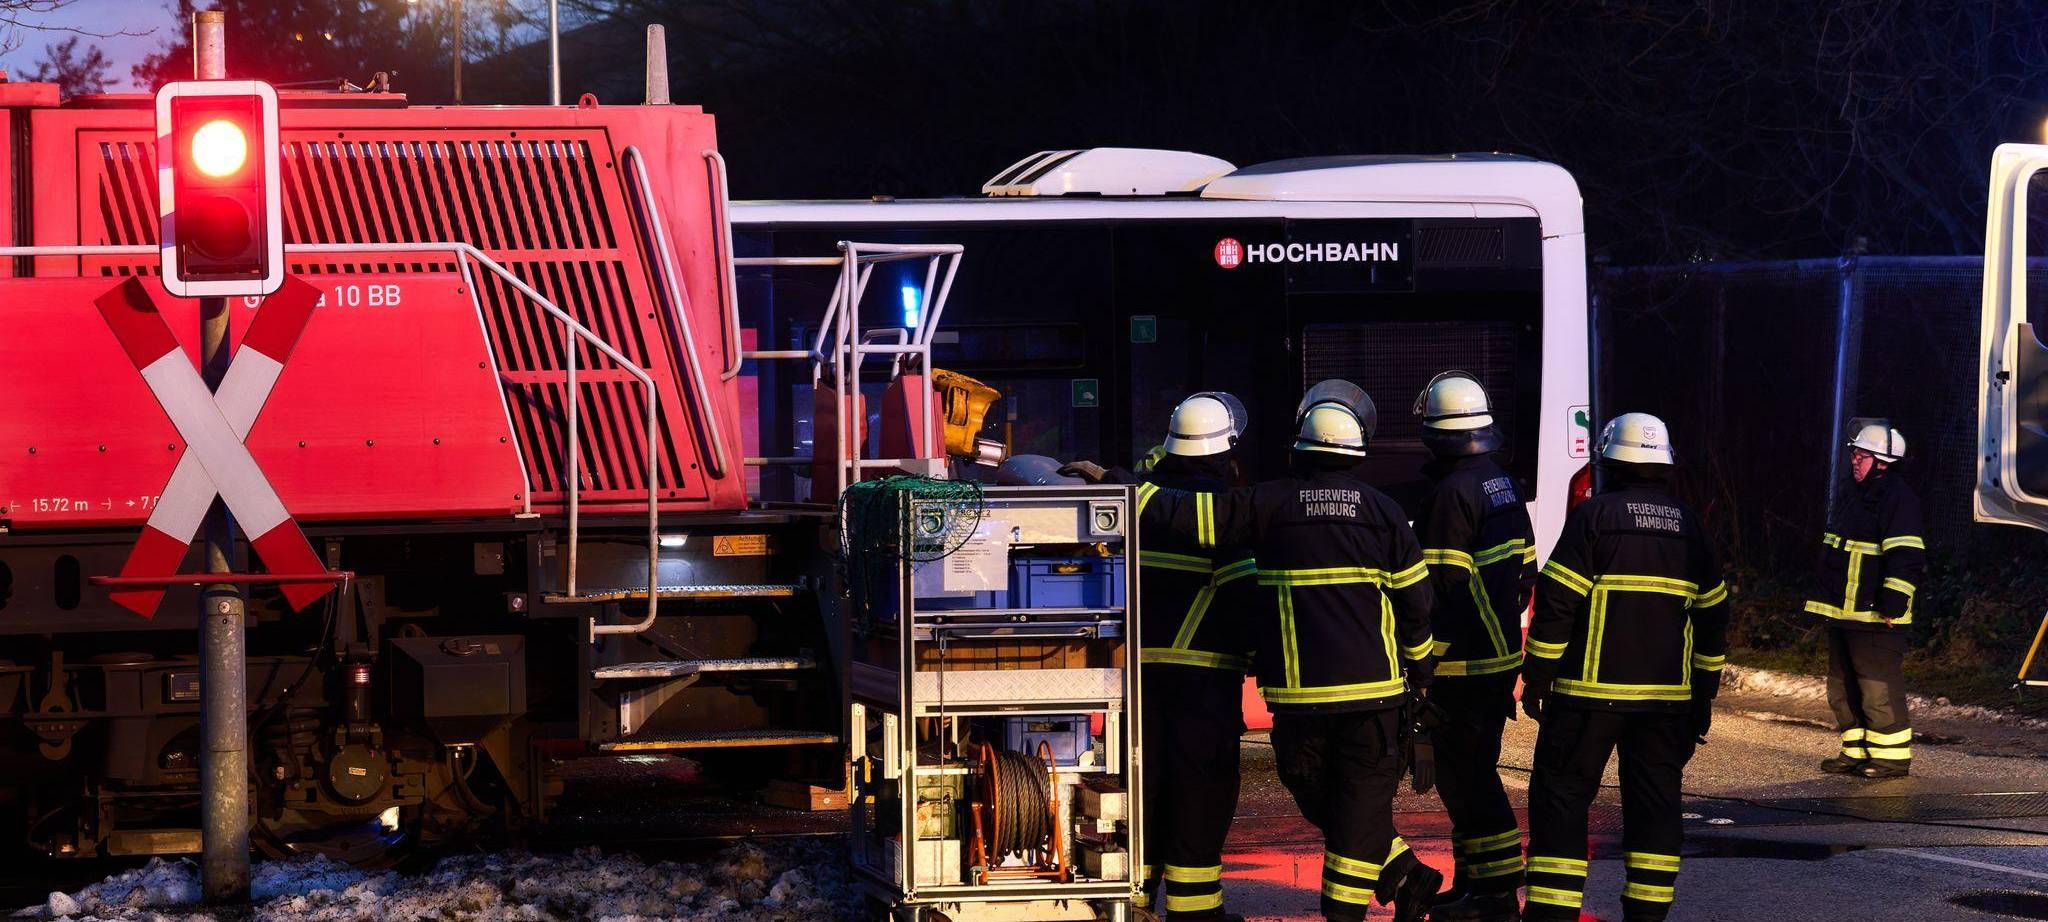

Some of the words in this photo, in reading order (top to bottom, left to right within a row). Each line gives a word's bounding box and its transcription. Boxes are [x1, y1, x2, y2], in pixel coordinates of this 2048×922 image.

[1247, 242, 1399, 263] HOCHBAHN
[335, 285, 360, 307] 10
[368, 285, 401, 306] BB
[32, 498, 69, 512] 15.72
[74, 500, 89, 511] m
[1299, 489, 1361, 504] FEUERWEHR
[1306, 503, 1356, 517] HAMBURG
[1626, 503, 1682, 520] FEUERWEHR
[1635, 515, 1680, 532] HAMBURG
